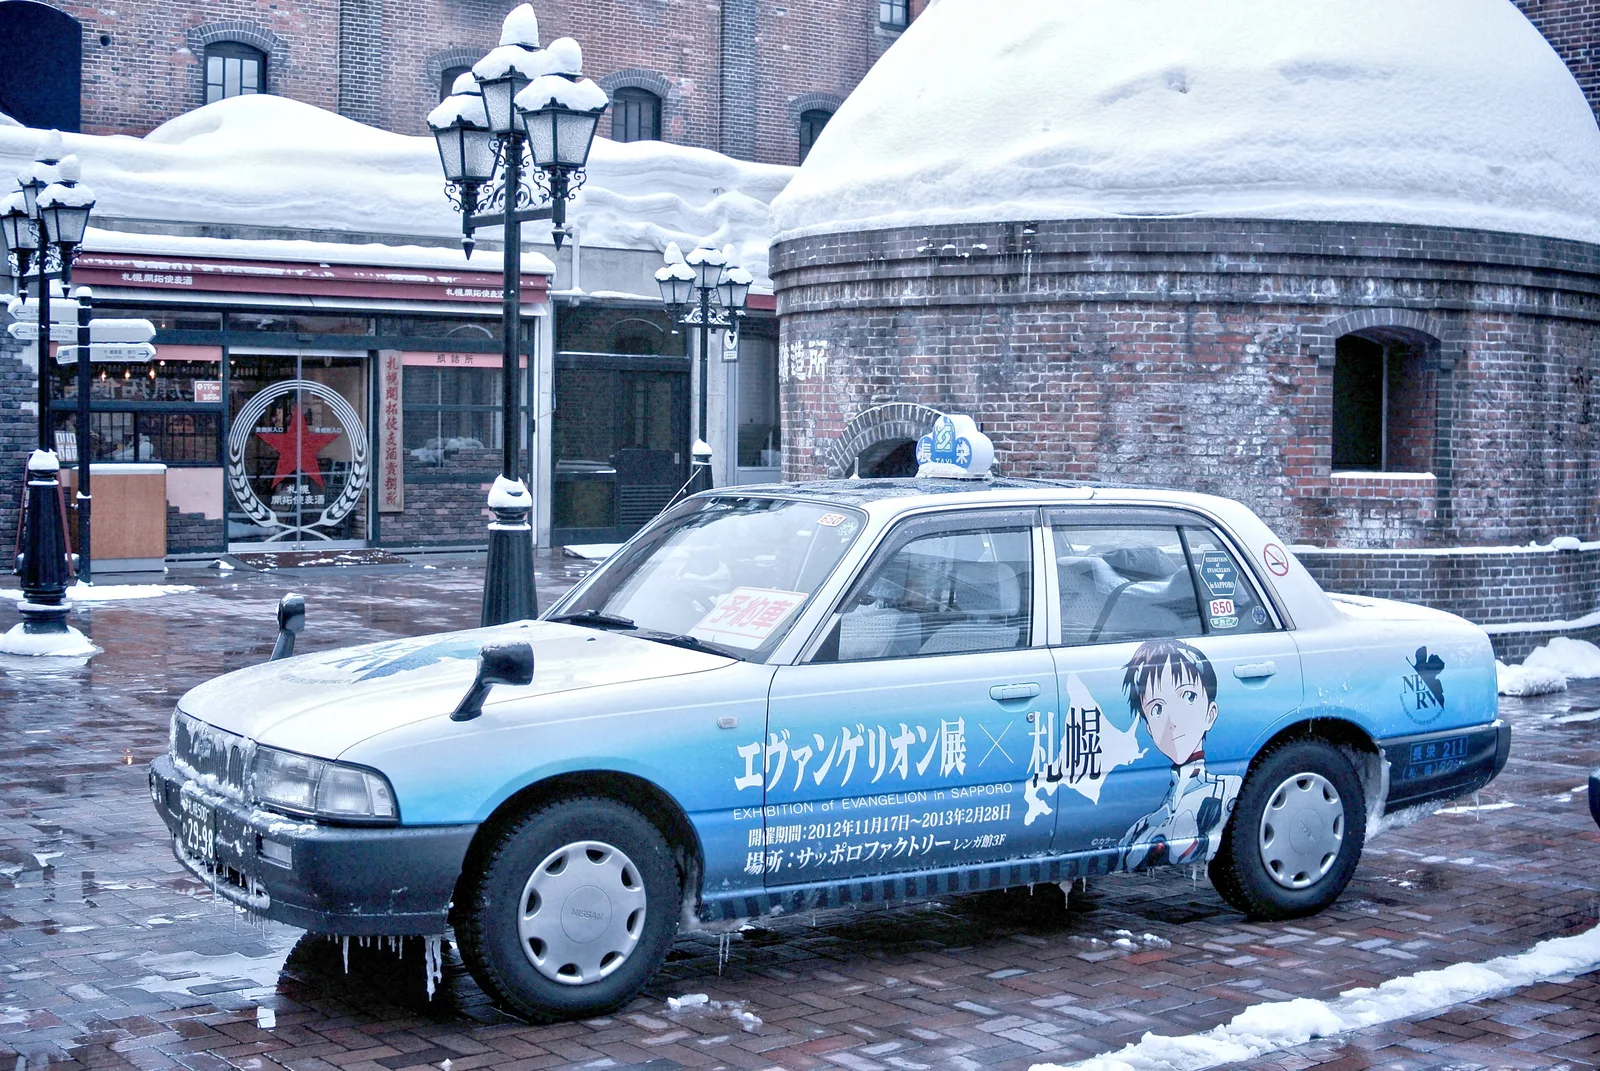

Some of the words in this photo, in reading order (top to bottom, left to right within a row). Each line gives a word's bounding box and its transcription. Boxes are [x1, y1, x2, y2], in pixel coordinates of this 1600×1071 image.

[820, 513, 843, 525] 650
[709, 594, 794, 631] 予約車
[1212, 600, 1233, 615] 650
[734, 715, 967, 793] エヴァンゲリオン展
[1026, 706, 1103, 789] 札幌
[1442, 738, 1464, 758] 211
[733, 802, 814, 821] EXHIBITION
[821, 799, 835, 812] of
[842, 790, 927, 810] EVANGELION
[933, 789, 945, 801] in
[951, 782, 1013, 799] SAPPORO
[953, 833, 1007, 851] レンガ館3F
[570, 908, 604, 921] NISSAN
